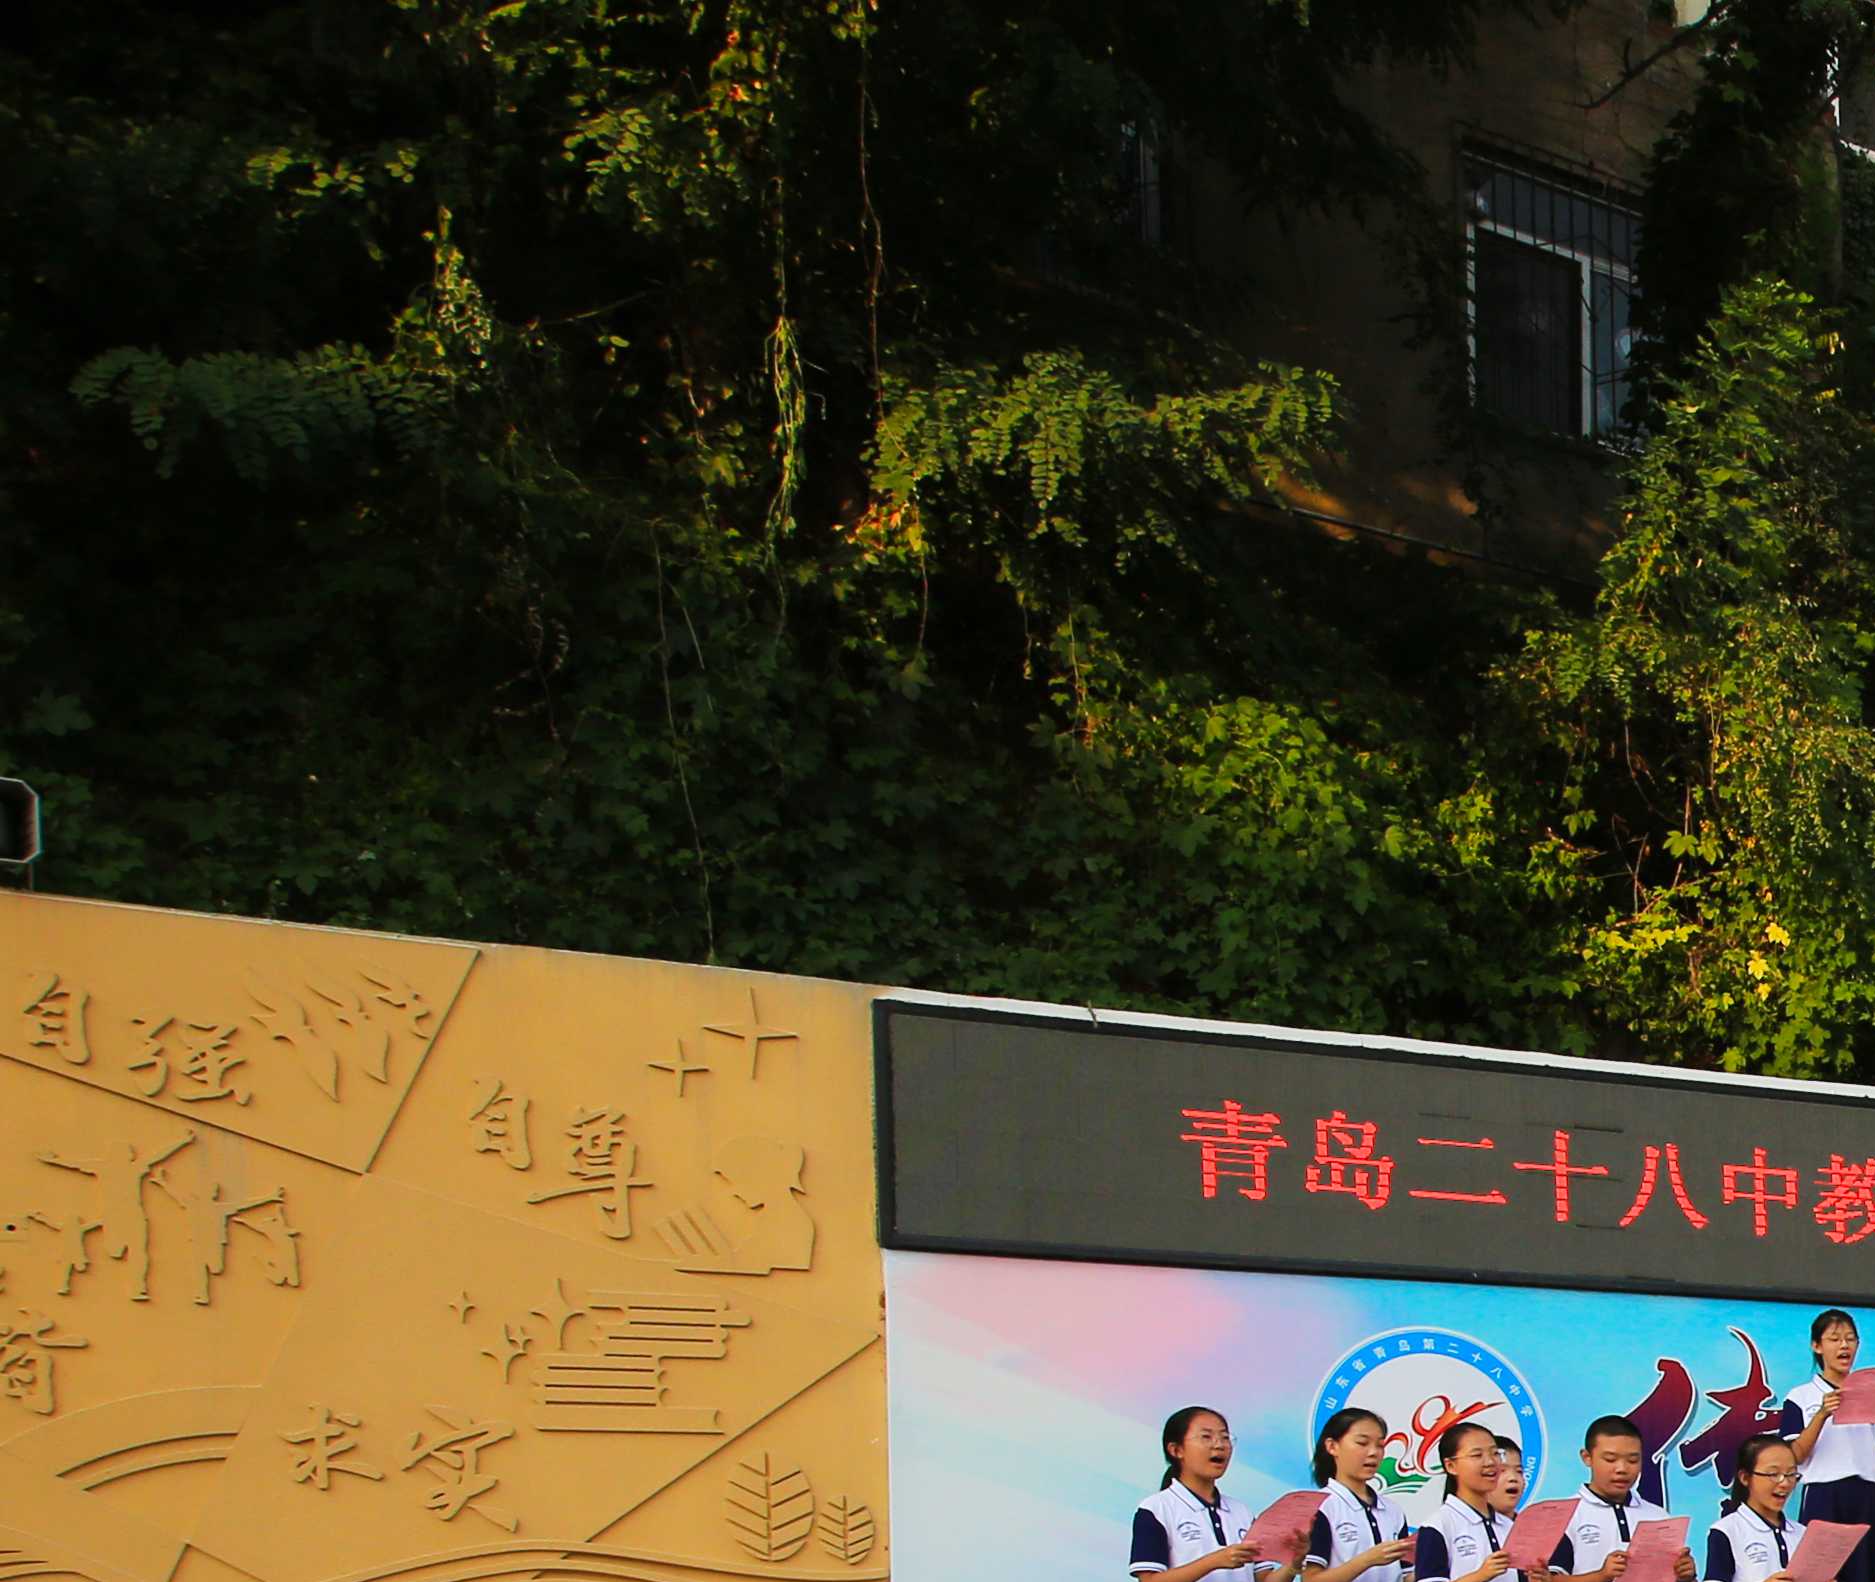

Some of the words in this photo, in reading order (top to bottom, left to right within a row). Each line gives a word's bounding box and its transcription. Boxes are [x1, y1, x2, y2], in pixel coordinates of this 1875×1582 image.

[23, 972, 253, 1107] 自强
[468, 1079, 655, 1241] 自尊
[280, 1403, 520, 1534] 求实
